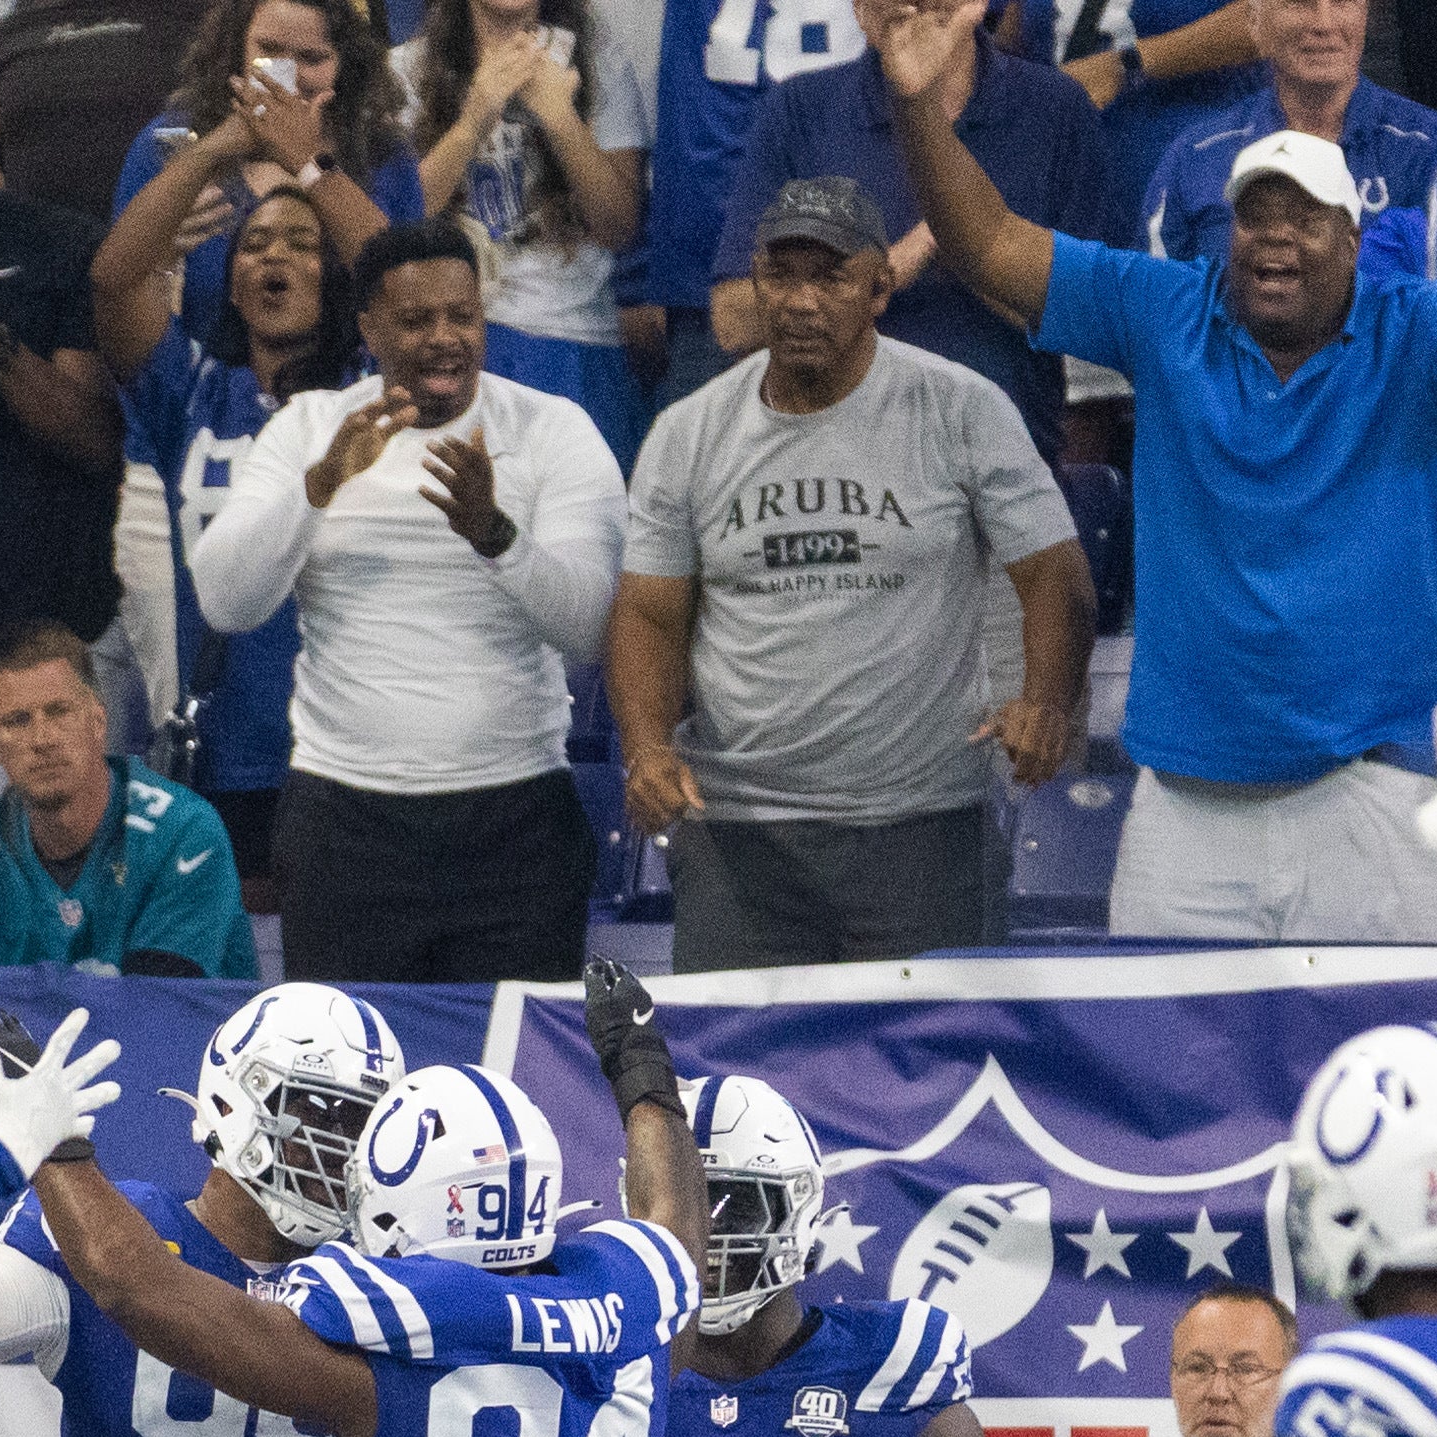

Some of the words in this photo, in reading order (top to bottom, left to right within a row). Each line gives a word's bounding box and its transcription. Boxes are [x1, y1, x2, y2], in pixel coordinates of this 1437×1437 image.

[720, 478, 913, 541] ARUBA
[777, 533, 845, 563] 1499
[771, 573, 826, 593] HAPPY
[836, 574, 905, 590] ISLAND
[475, 1175, 551, 1241] 94
[482, 1244, 536, 1263] COLTS
[508, 1292, 624, 1353] LEWIS
[800, 1391, 838, 1418] 40
